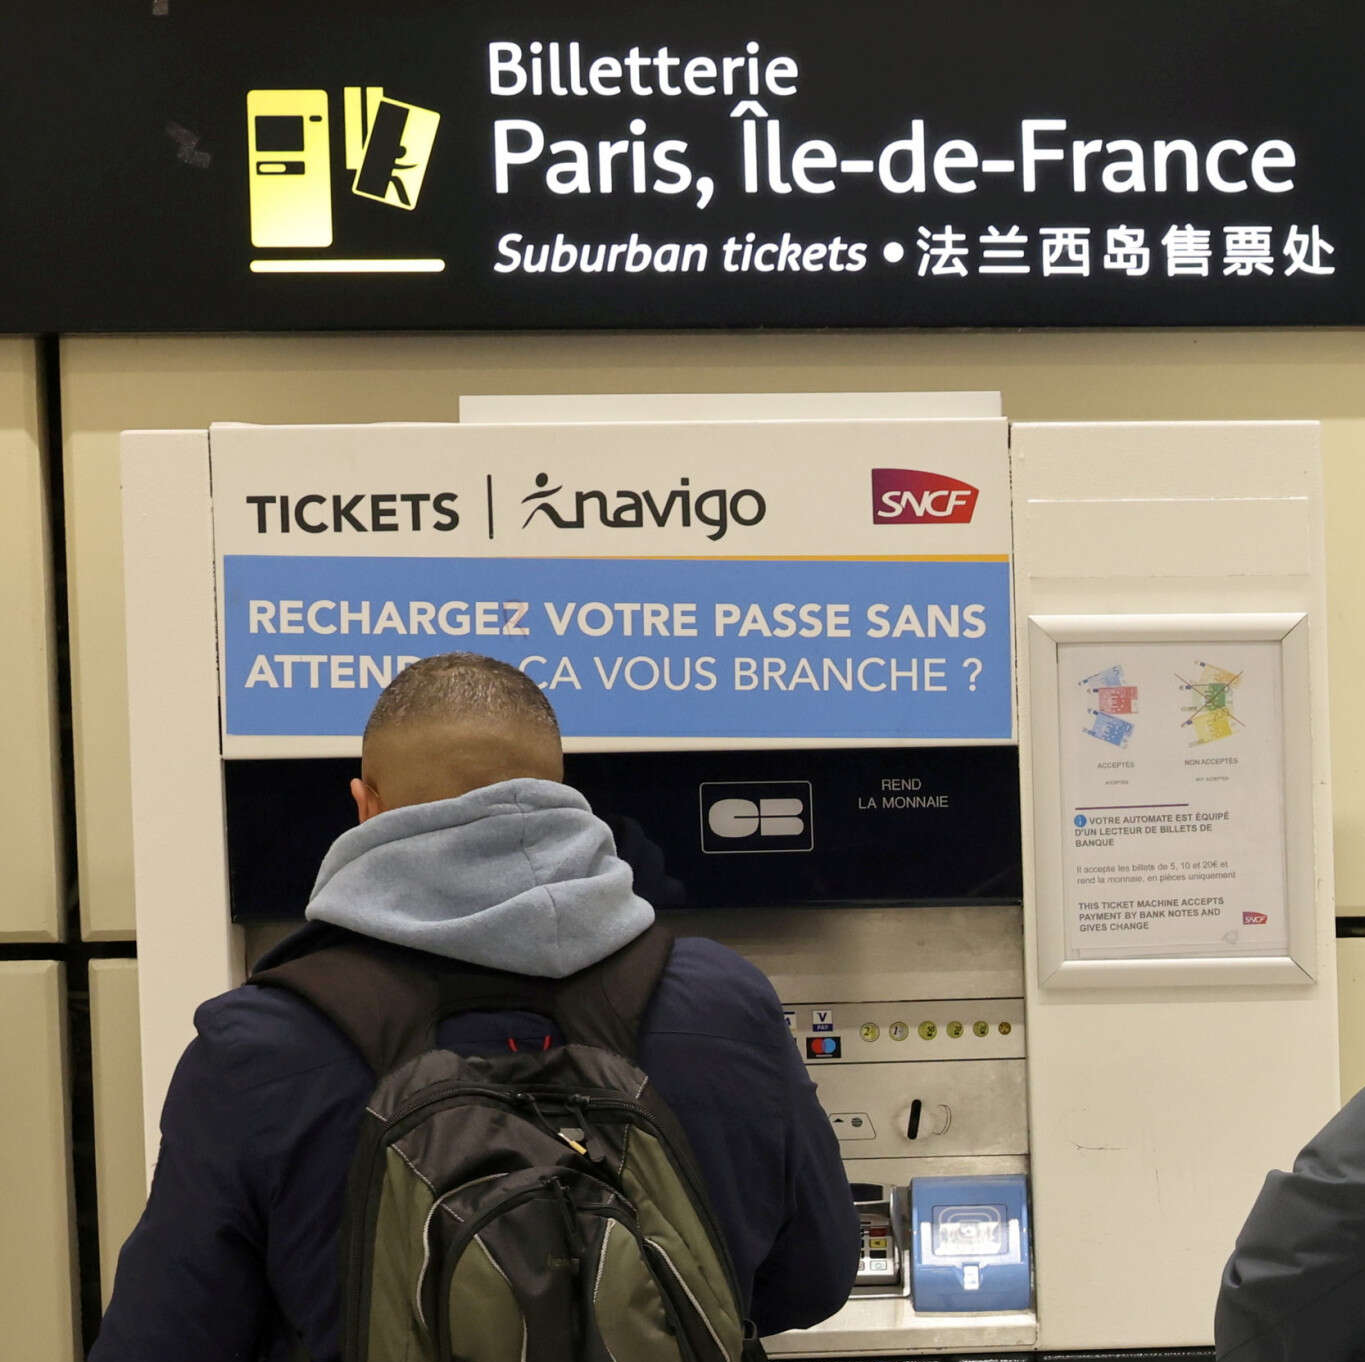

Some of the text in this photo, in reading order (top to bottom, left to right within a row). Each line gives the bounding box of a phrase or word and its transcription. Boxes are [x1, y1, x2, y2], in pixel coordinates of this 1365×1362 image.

[488, 41, 799, 97] Billetterie
[492, 100, 1297, 209] Paris, Île-de-France
[494, 232, 867, 275] Suburban tickets
[916, 224, 1337, 278] 法兰西岛售票处
[246, 476, 768, 542] TICKETS navigo
[876, 489, 969, 519] SNCF
[248, 599, 988, 639] RECHARGEZ VOTRE PASSE SANS
[597, 656, 718, 692] VOUS
[733, 656, 948, 693] BRANCHE
[966, 657, 983, 693] ?
[881, 778, 923, 791] REND
[857, 795, 949, 809] LA MONNAIE
[1089, 811, 1230, 825] VOTRE AUTOMATE EST ÉQUIPÉ
[1075, 823, 1213, 837] D'UN LECTEUR DE BILLETS DE
[1075, 837, 1115, 848] BANQUE
[1180, 861, 1191, 870] 10
[1188, 871, 1237, 882] uniquement
[1078, 896, 1225, 911] THIS TICKET MACHINE ACCEPTS
[1079, 908, 1221, 921] PAYMENT BY BANK NOTES AND
[1079, 921, 1150, 933] GIVES CHANGE
